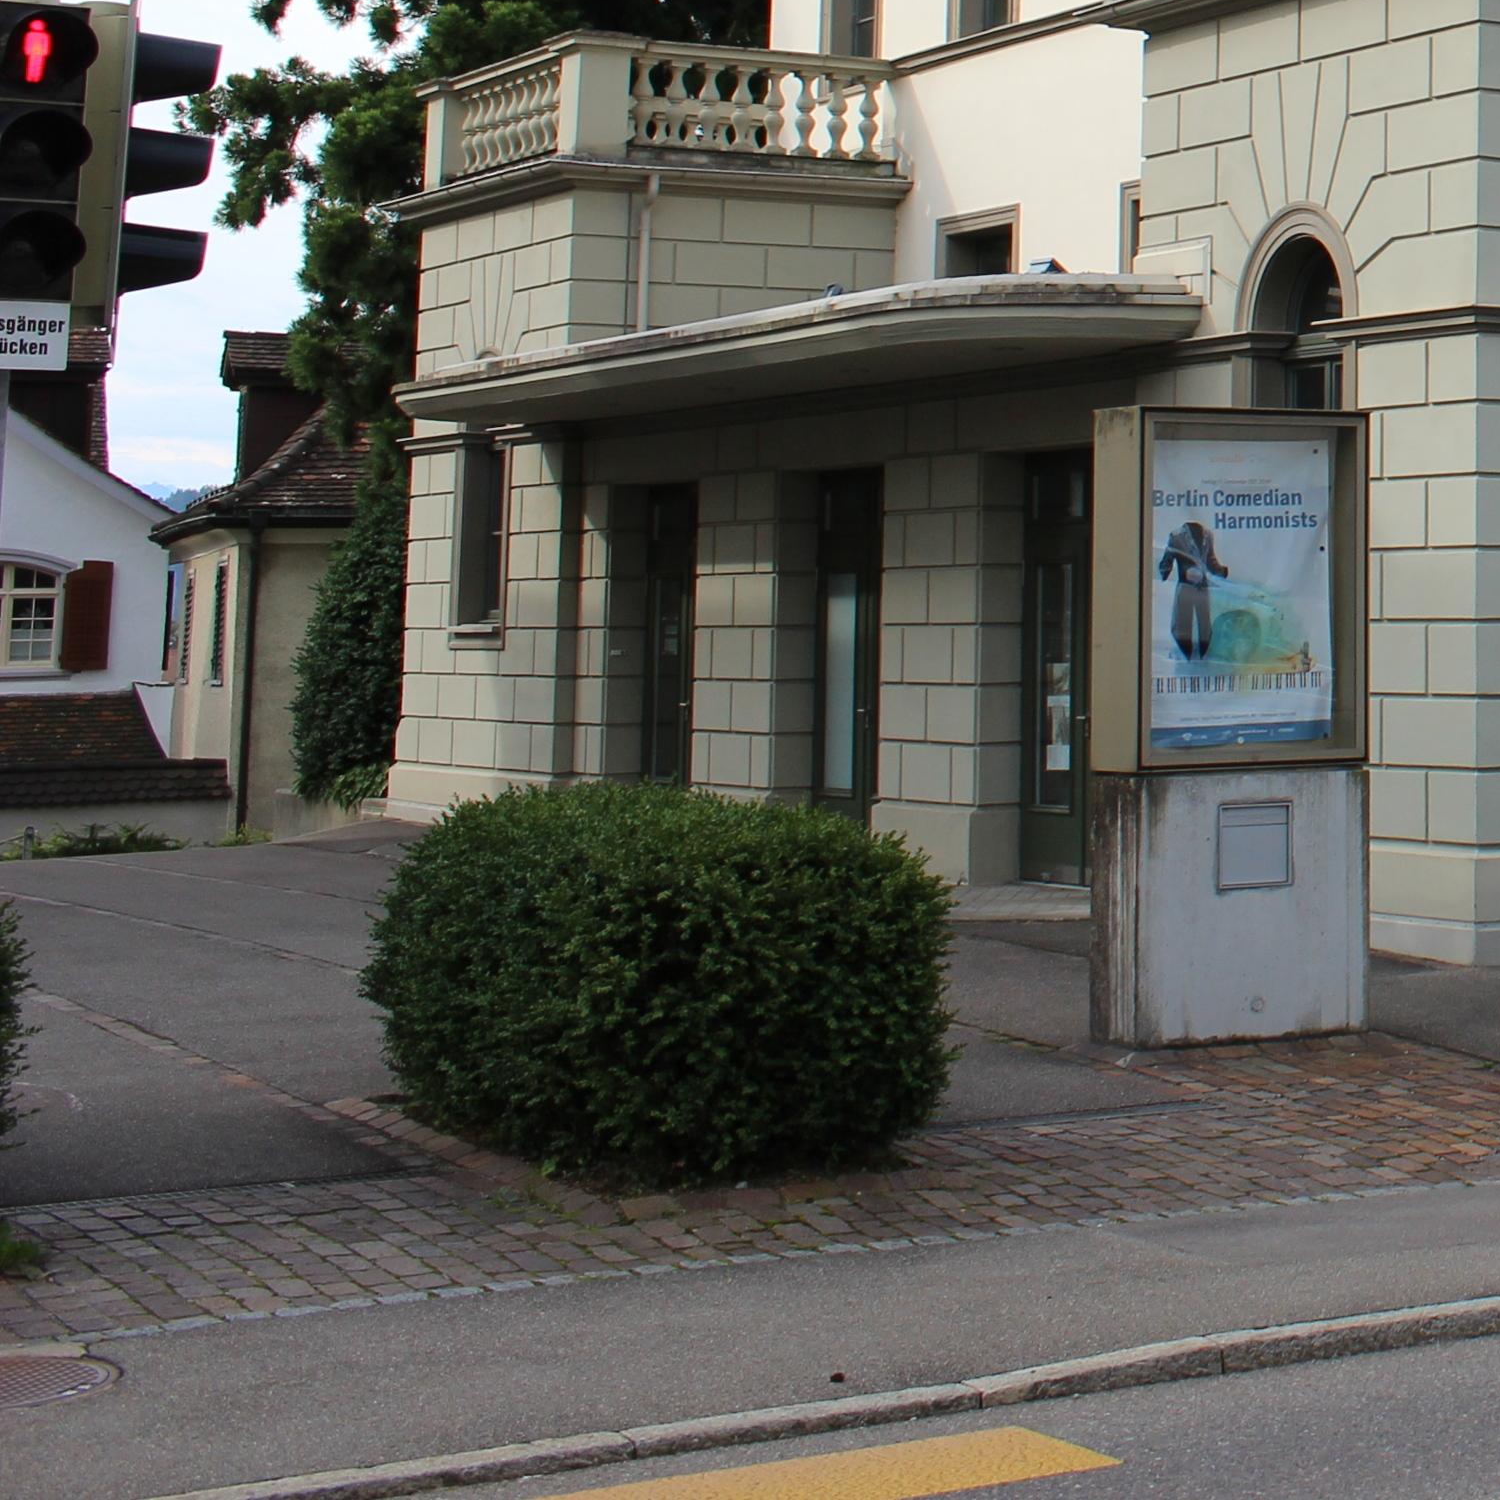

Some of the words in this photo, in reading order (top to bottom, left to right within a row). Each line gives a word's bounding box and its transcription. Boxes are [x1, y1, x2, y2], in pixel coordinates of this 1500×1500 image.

[1152, 489, 1209, 507] Berlin
[1213, 489, 1302, 507] Comedian
[1214, 511, 1318, 529] Harmonists
